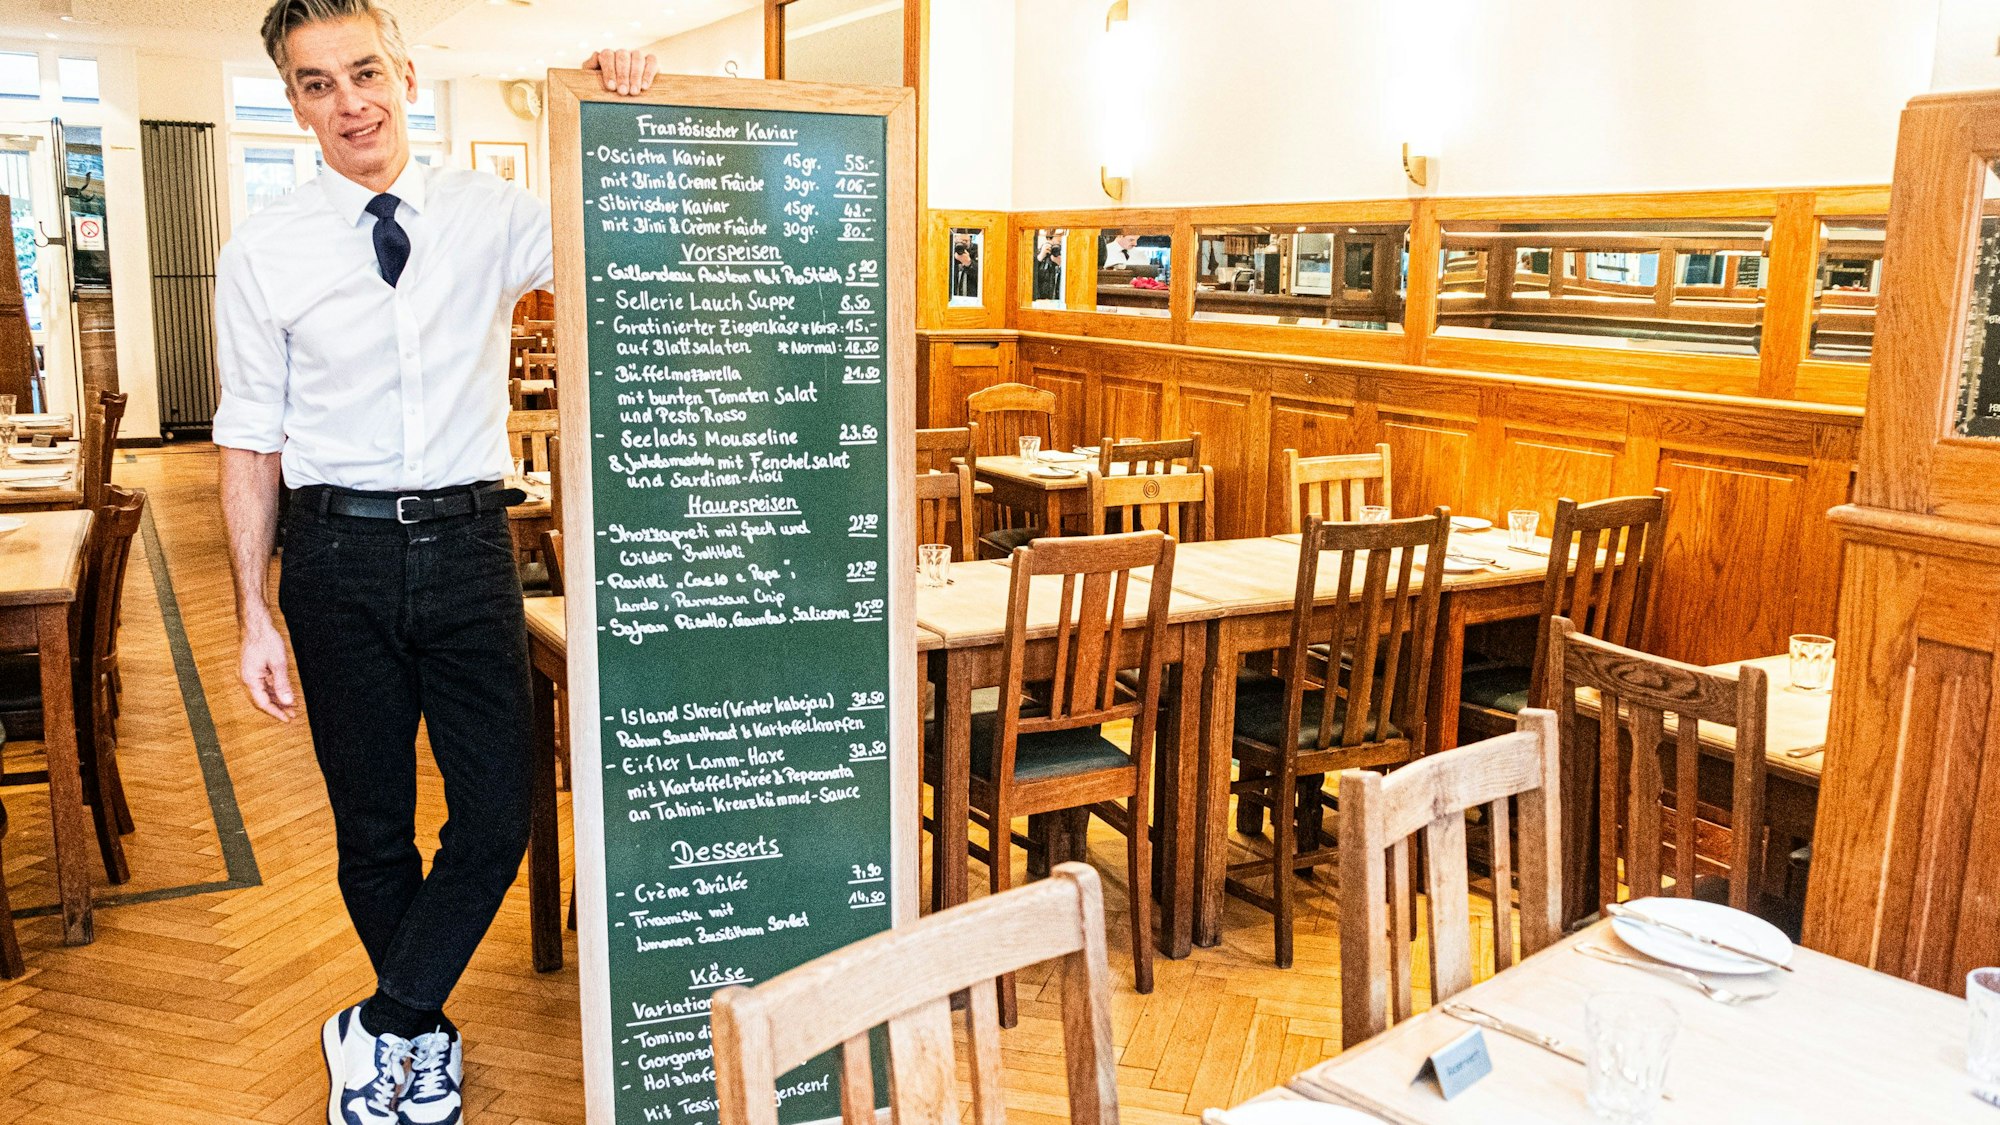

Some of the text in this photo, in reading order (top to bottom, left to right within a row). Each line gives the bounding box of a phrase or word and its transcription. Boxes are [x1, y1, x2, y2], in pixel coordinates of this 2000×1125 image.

[635, 113, 798, 140] Französischer Kaviar
[597, 144, 667, 165] Oscietra
[672, 148, 725, 166] Kaviar
[600, 171, 628, 188] mit
[598, 193, 679, 213] Sibirischer
[681, 198, 729, 215] Kaviar
[601, 216, 629, 231] mit
[681, 239, 781, 260] Vorspeisen
[615, 289, 683, 311] Sellerie
[689, 291, 743, 311] Lauch
[746, 289, 795, 311] Suppe
[613, 315, 715, 336] Gratinierter
[718, 314, 799, 337] Ziegenkäse
[616, 339, 648, 355] auf
[652, 337, 751, 355] Blattsalaten
[614, 362, 742, 382] Büffelmozzarella
[617, 381, 817, 406] mit bunten Tomaten Salat
[620, 403, 746, 423] und Pesto Rosso
[620, 426, 697, 448] Seelachs
[704, 430, 797, 446] Mousseline
[717, 453, 743, 470] mit
[749, 450, 850, 472] Fenchelsalat
[626, 467, 783, 488] und Sardinen-Aioli
[688, 493, 800, 514] Haupspeisen
[714, 522, 737, 537] mit
[779, 519, 810, 535] und
[619, 543, 745, 566] Wilder Brokkoli
[607, 572, 668, 589] Ravioli
[670, 590, 749, 607] Parmesan
[753, 587, 785, 607] Chip
[609, 617, 668, 644] Safran
[621, 705, 678, 725] Island
[682, 702, 721, 720] Skrei
[615, 730, 661, 748] Rahm
[752, 716, 865, 738] Kartoffelkrapfen
[622, 754, 679, 774] Eifler
[627, 780, 657, 800] mit
[658, 766, 772, 798] Kartoffelpürée
[781, 763, 854, 784] Peperonata
[628, 809, 650, 822] an
[670, 835, 780, 865] Desserts
[634, 882, 689, 902] Crème
[692, 871, 747, 894] Brûlée
[628, 909, 703, 930] Tiramisu
[708, 902, 733, 917] mit
[635, 911, 809, 952] Limonen Basilikum Sorbet
[690, 962, 748, 985] Käse
[633, 1029, 695, 1049] Tomino
[636, 1034, 714, 1070] Gorgonzol
[642, 1064, 717, 1092] Holzhofe
[774, 1072, 830, 1108] gensenf
